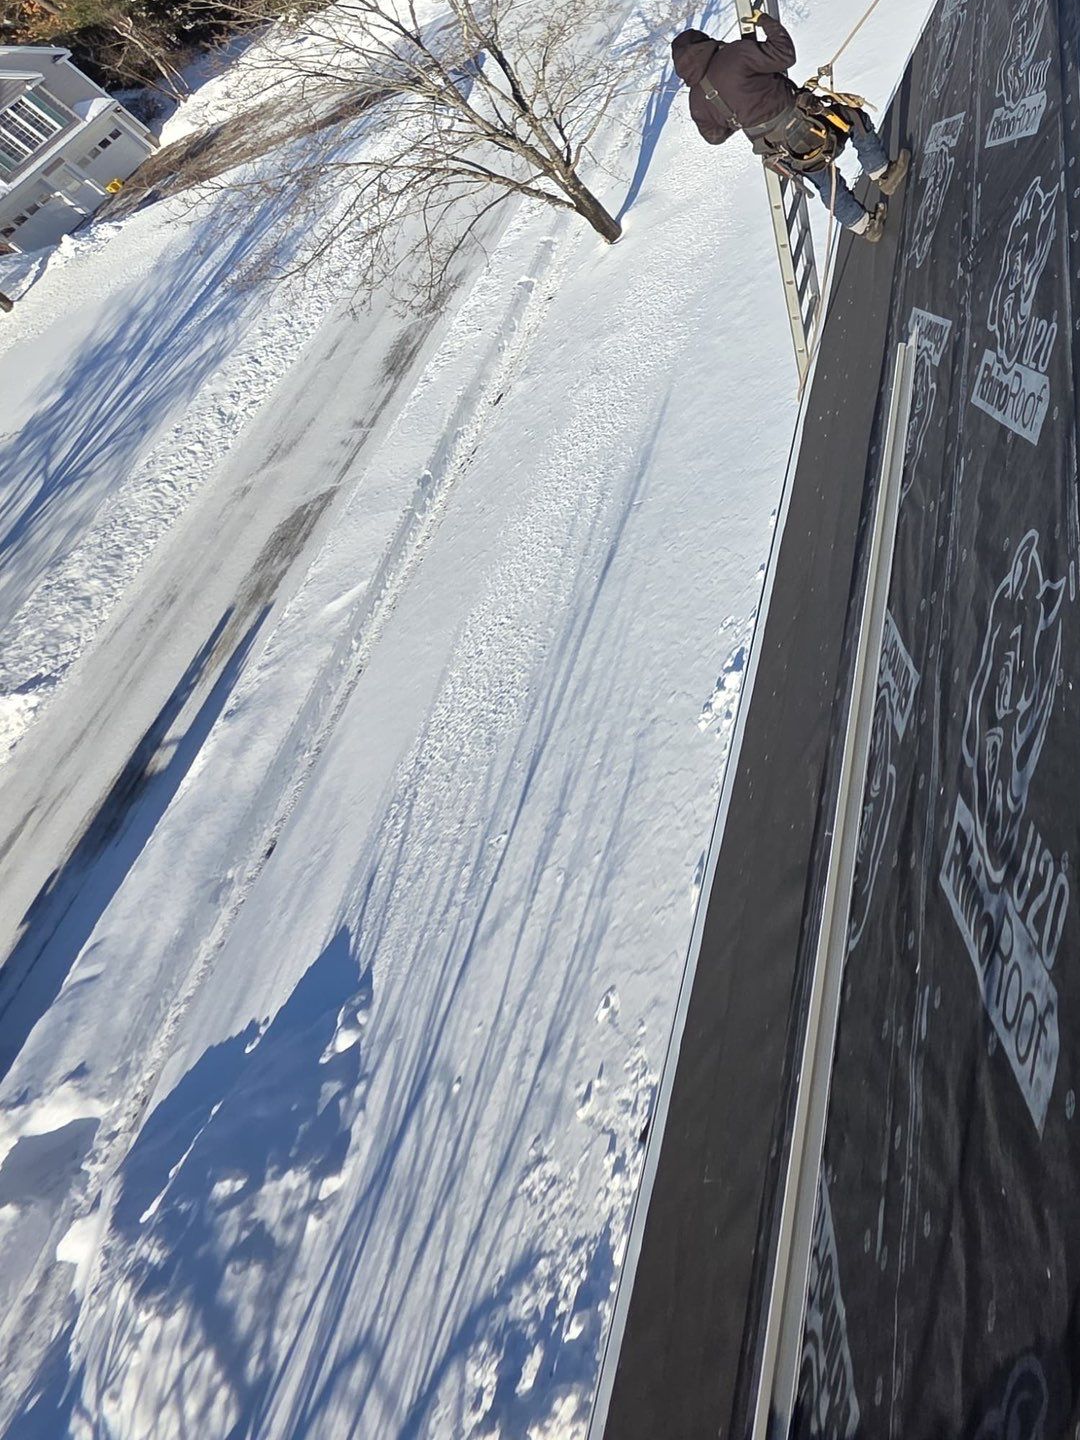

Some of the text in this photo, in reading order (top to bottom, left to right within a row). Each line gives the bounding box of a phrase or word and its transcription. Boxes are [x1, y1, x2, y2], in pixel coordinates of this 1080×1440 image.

[1026, 57, 1052, 96] U20
[1022, 316, 1058, 373] U20
[976, 362, 1048, 431] RhinoRoof
[1013, 820, 1069, 970] U20
[950, 822, 1055, 1088] RhinoRoof
